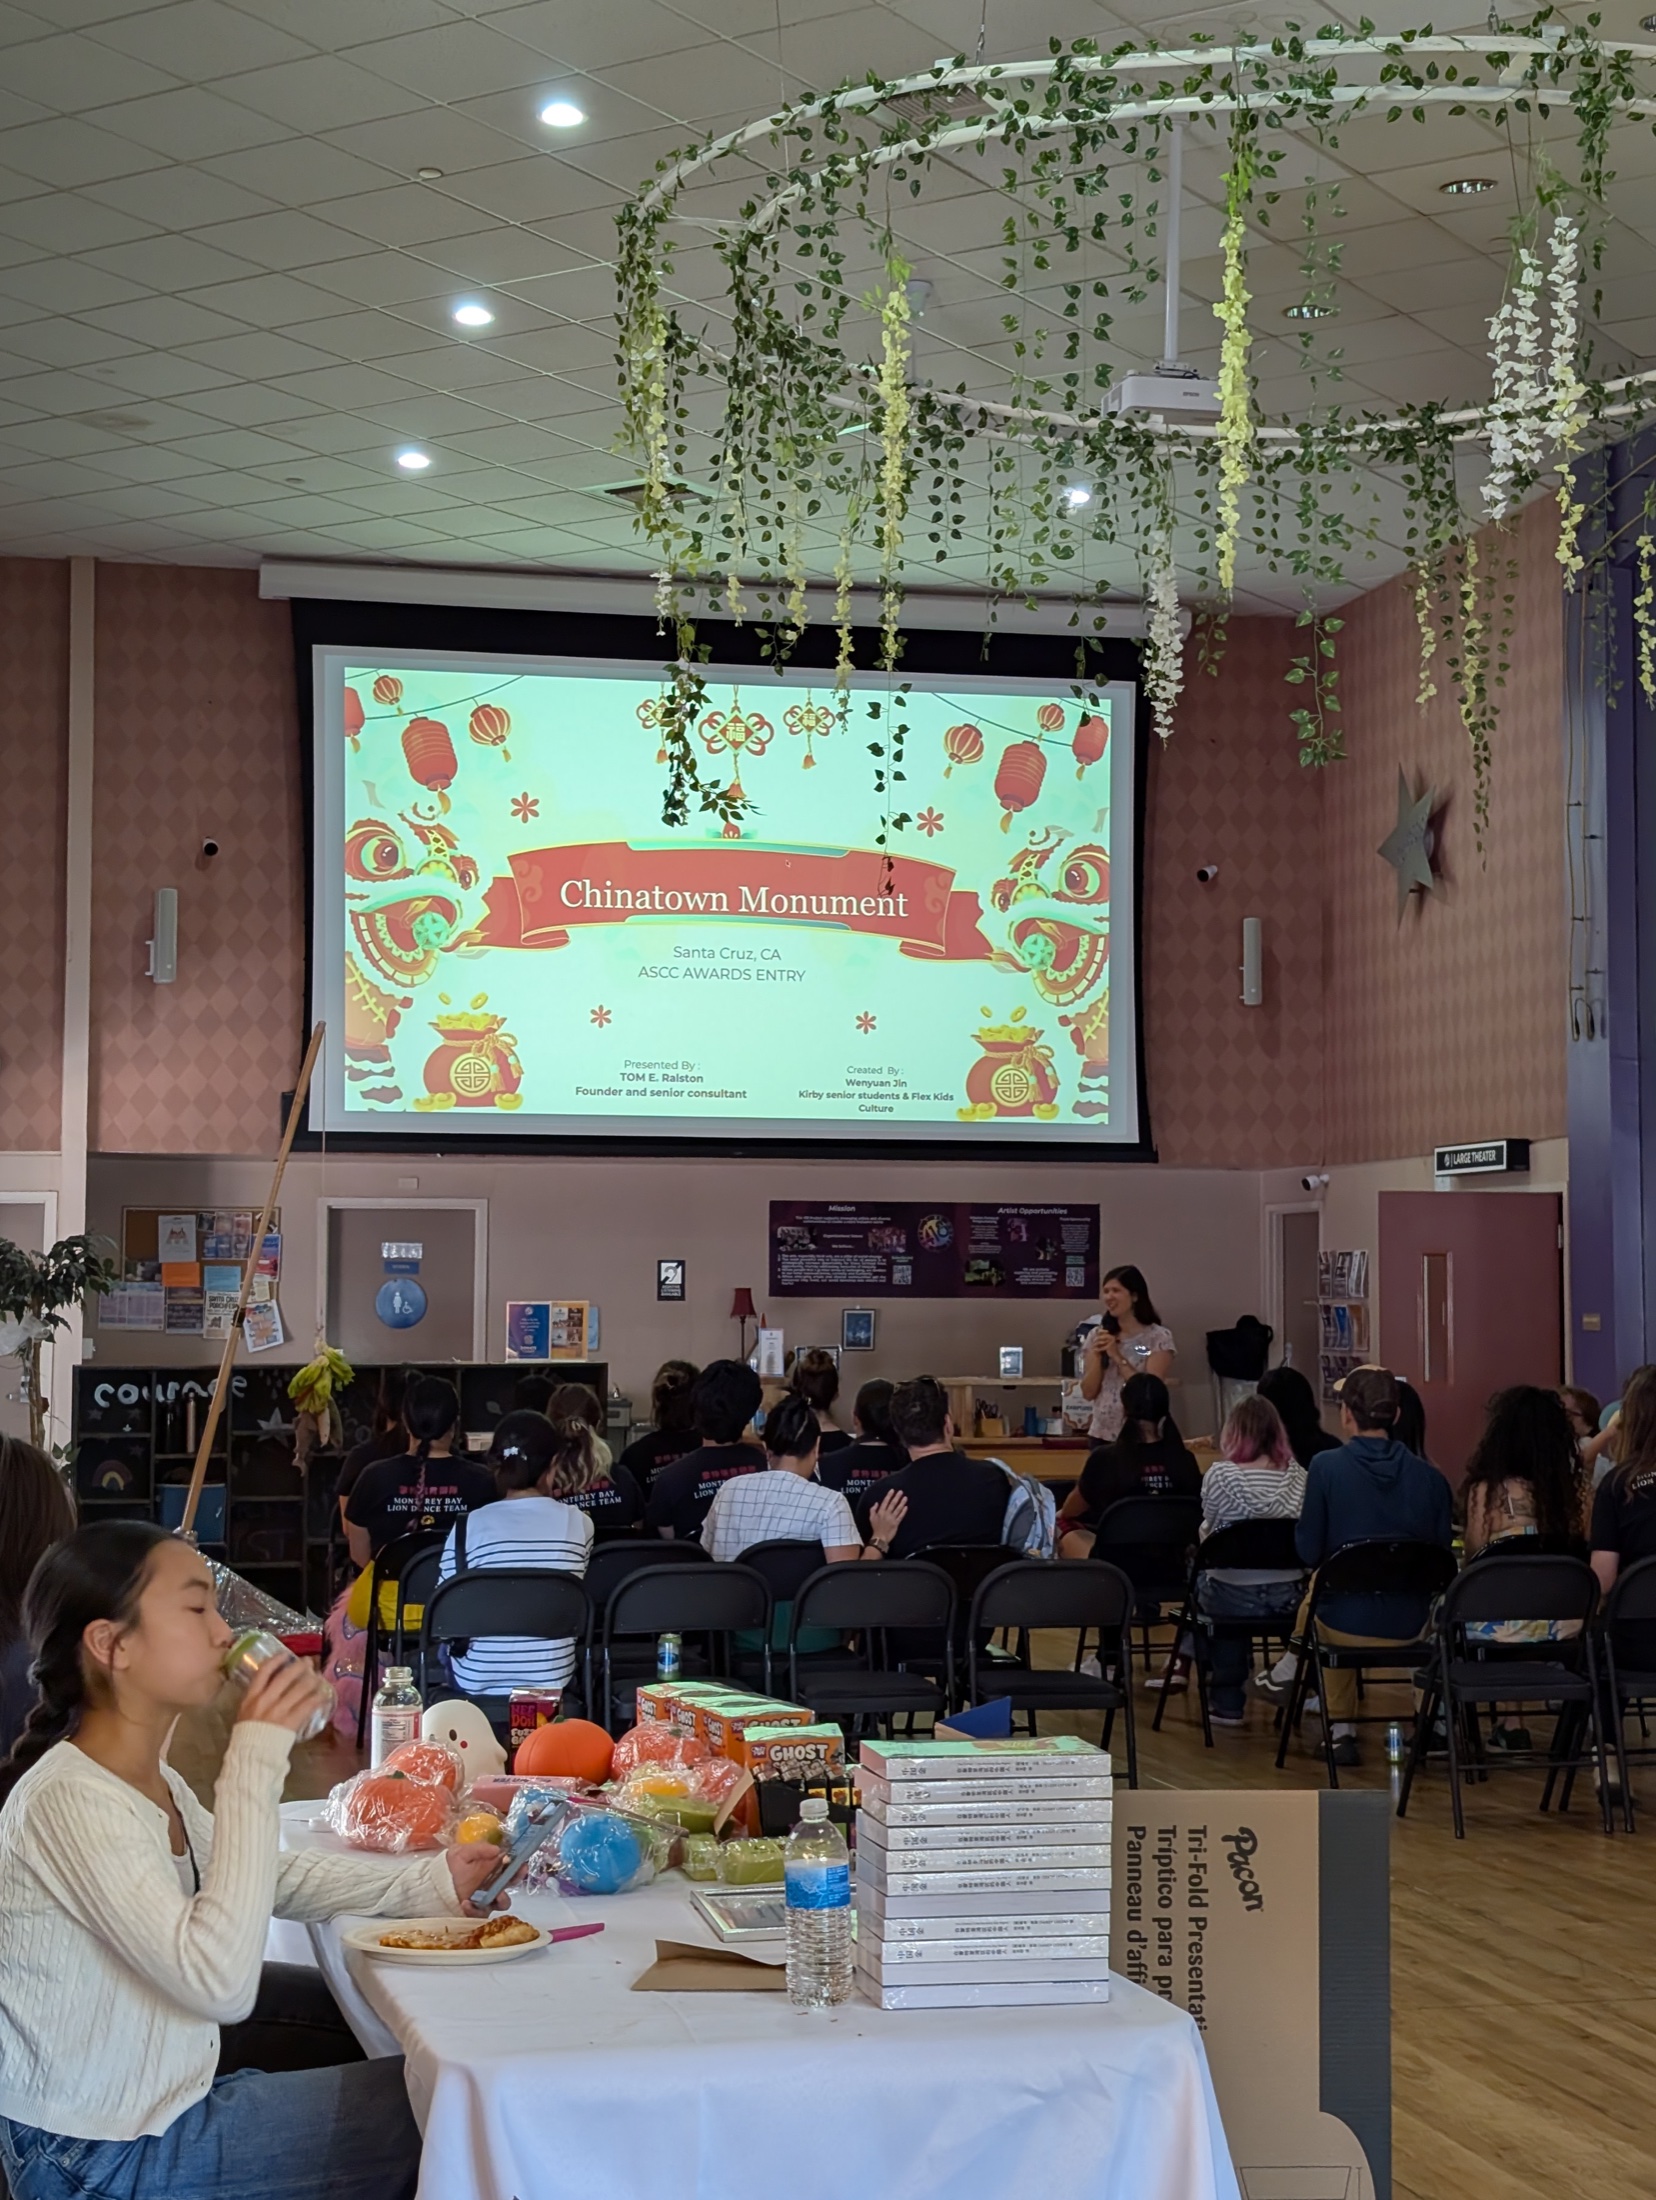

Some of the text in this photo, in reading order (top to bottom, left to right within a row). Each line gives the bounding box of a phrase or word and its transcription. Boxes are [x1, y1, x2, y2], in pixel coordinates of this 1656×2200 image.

[725, 722, 746, 743] 福
[559, 878, 910, 918] Chinatown Monument
[673, 945, 782, 962] Santa Cruz, CA
[637, 965, 806, 982] ASCC AWARDS ENTRY
[623, 1059, 679, 1070] Presented
[681, 1060, 696, 1073] By
[846, 1065, 884, 1076] Created
[887, 1066, 900, 1077] By
[619, 1072, 704, 1084] TOM E. Ralston
[845, 1078, 908, 1089] Wenyuan Jin
[575, 1086, 748, 1100] Founder and senior consultant
[798, 1089, 955, 1102] Kirby senior students & Flex Kids
[858, 1103, 895, 1114] Culture
[1453, 1149, 1497, 1165] LARGE THEATER
[828, 1204, 857, 1213] Mission
[997, 1206, 1069, 1216] Artist Opportunities
[1631, 1477, 1655, 1490] LION
[597, 1489, 616, 1499] BAY
[693, 1487, 716, 1499] LION
[840, 1486, 862, 1495] LION
[393, 1496, 463, 1505] MONTREY BAY
[597, 1495, 623, 1507] TEAM
[386, 1503, 468, 1513] LION DNCE TEAM
[769, 1743, 829, 1762] GHOST
[1151, 1824, 1178, 1910] Tríptico
[1187, 1824, 1209, 1909] Tri-Fold
[1220, 1826, 1264, 1913] Pacon
[1126, 1825, 1147, 1922] Panneau
[1151, 1916, 1174, 1967] para
